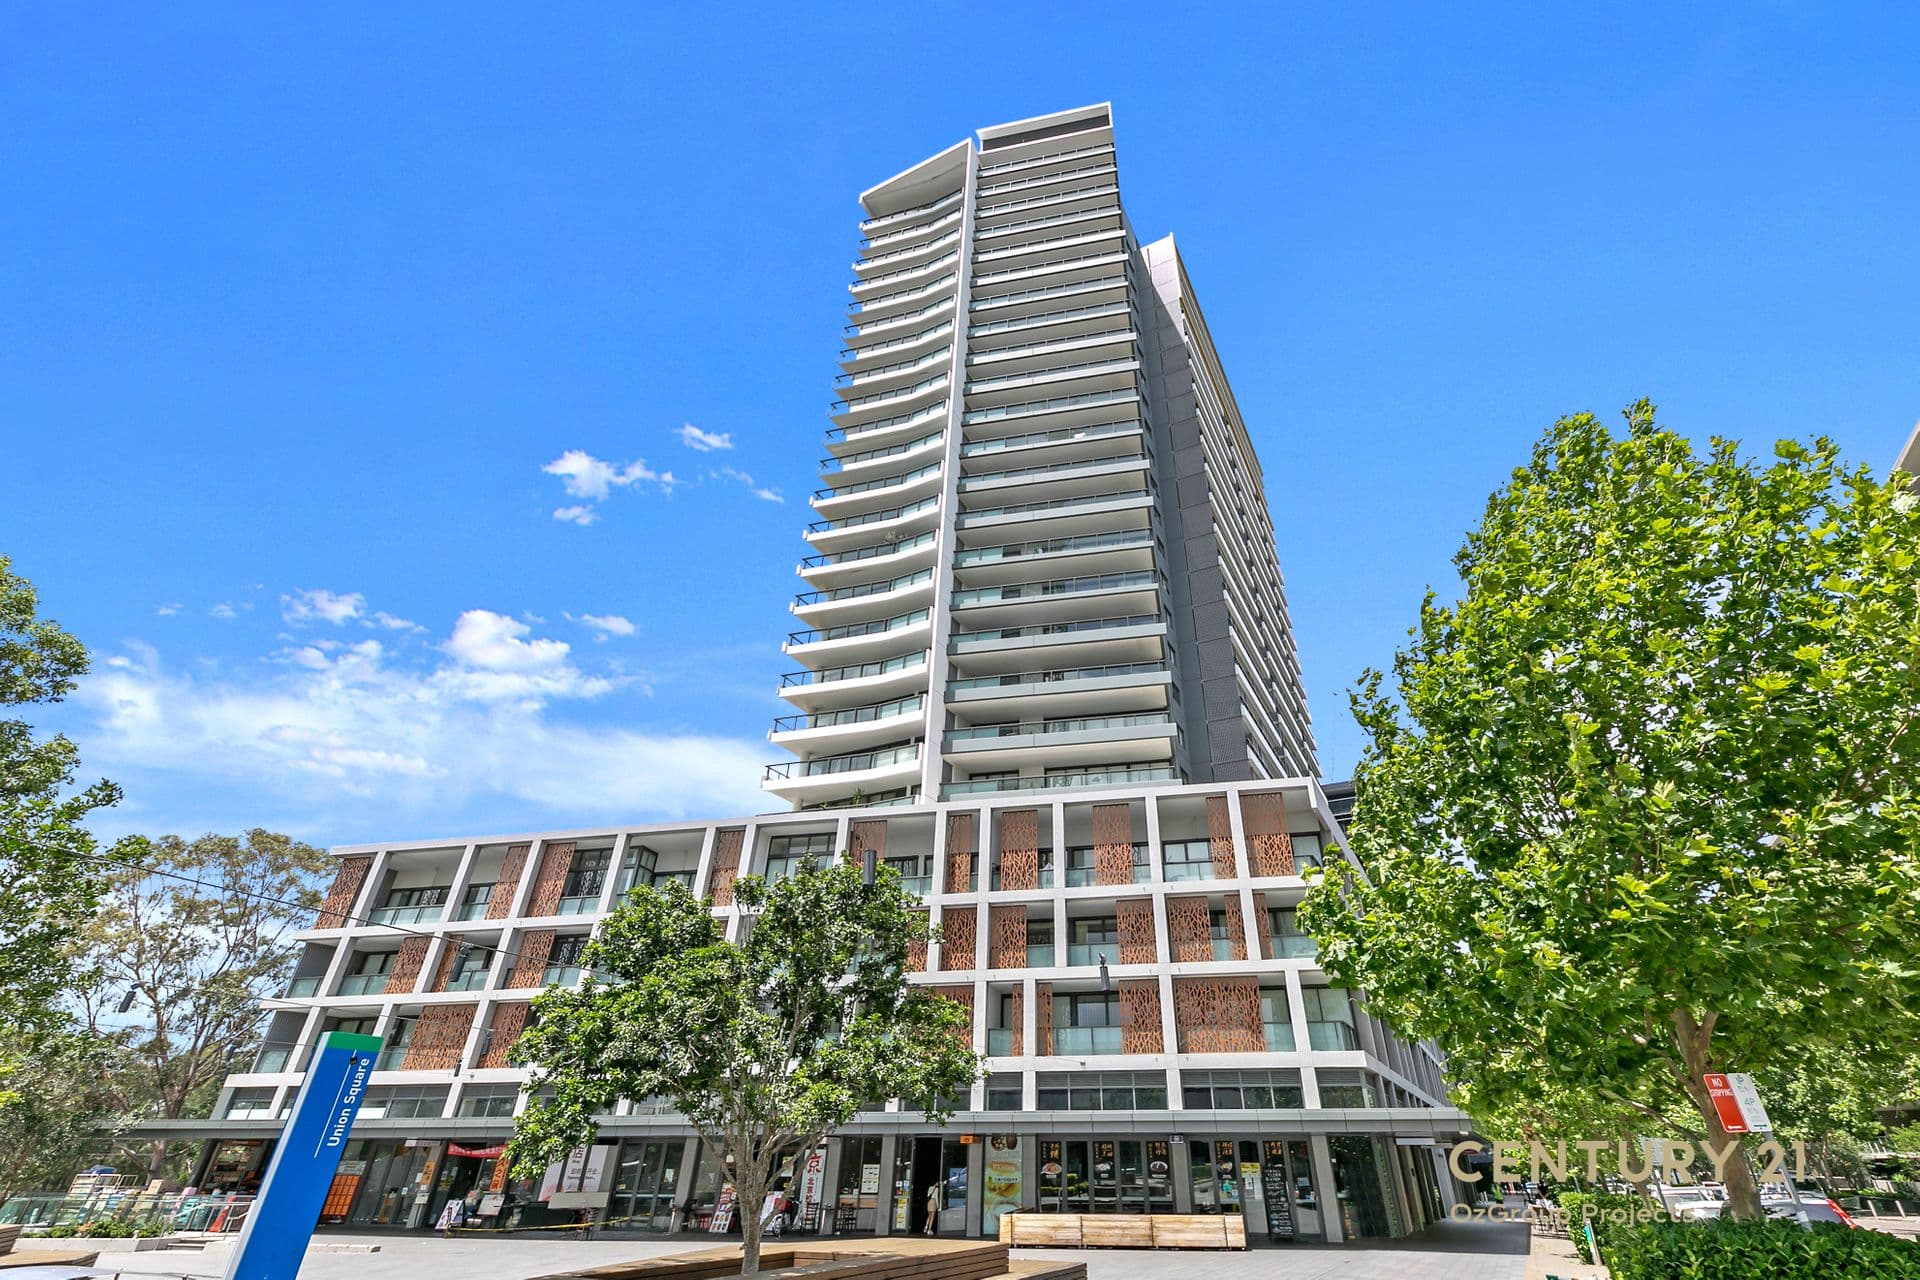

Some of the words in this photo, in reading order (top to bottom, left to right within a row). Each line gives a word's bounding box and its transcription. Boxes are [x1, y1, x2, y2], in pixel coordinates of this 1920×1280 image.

[327, 1108, 352, 1147] Union
[344, 1058, 370, 1104] Square
[1711, 1078, 1723, 1087] NO
